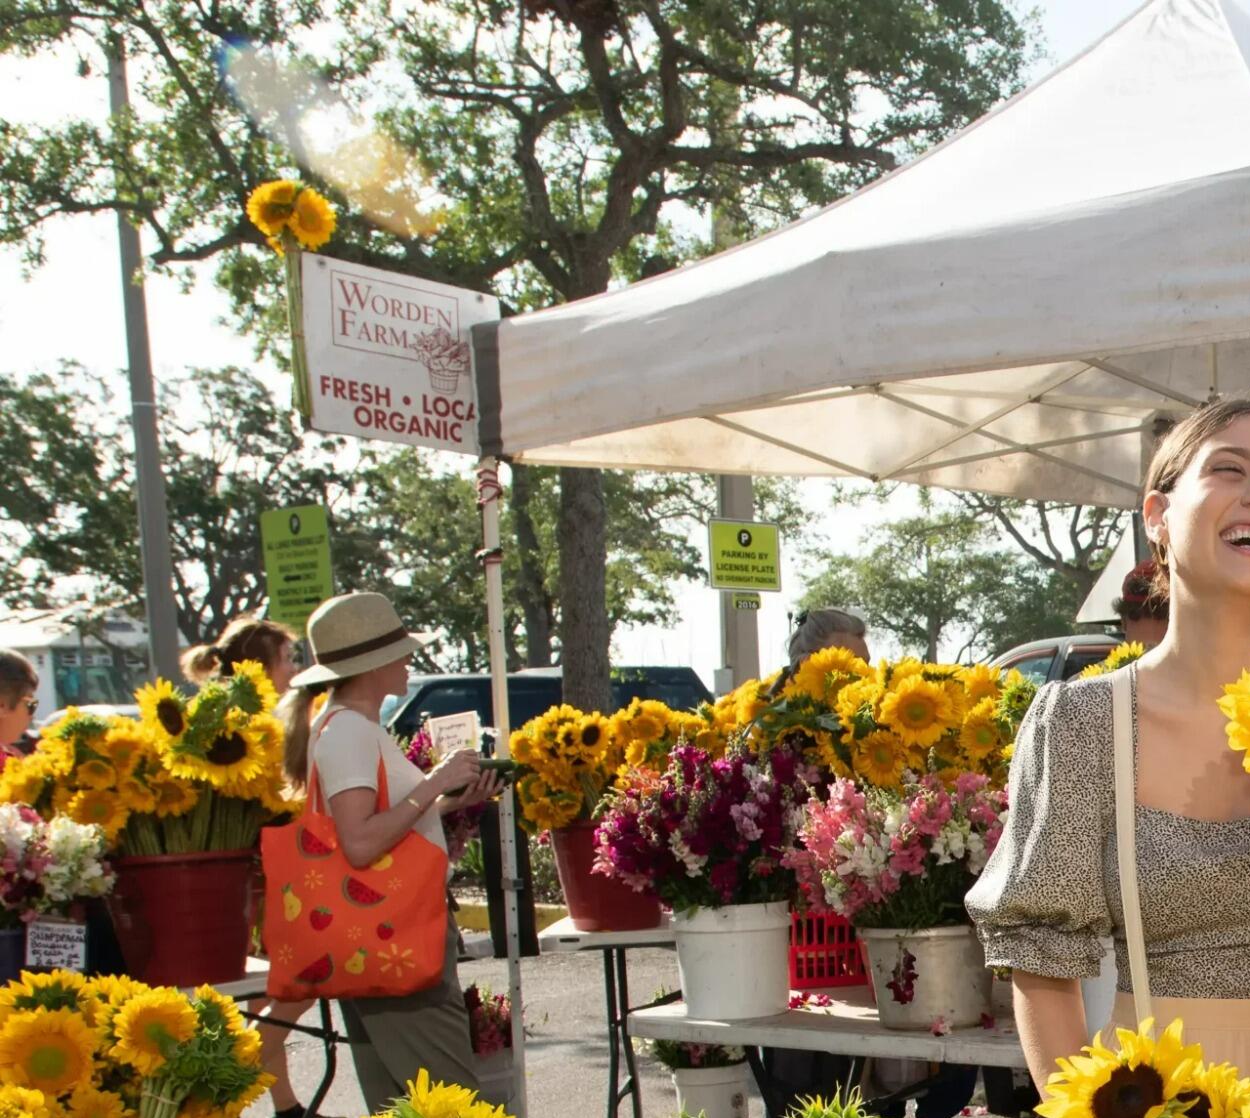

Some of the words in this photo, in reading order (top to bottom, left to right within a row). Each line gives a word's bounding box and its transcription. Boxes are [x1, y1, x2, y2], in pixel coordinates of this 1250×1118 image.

[337, 278, 452, 328] WORDEN
[339, 308, 409, 349] FARM
[320, 375, 391, 407] FRESH
[423, 394, 476, 421] LOCA
[354, 406, 463, 443] ORGANIC
[716, 563, 749, 573] LICENSE
[751, 564, 775, 574] PLATE
[721, 550, 757, 560] PARKING
[758, 551, 769, 560] BY
[737, 600, 757, 609] 2016
